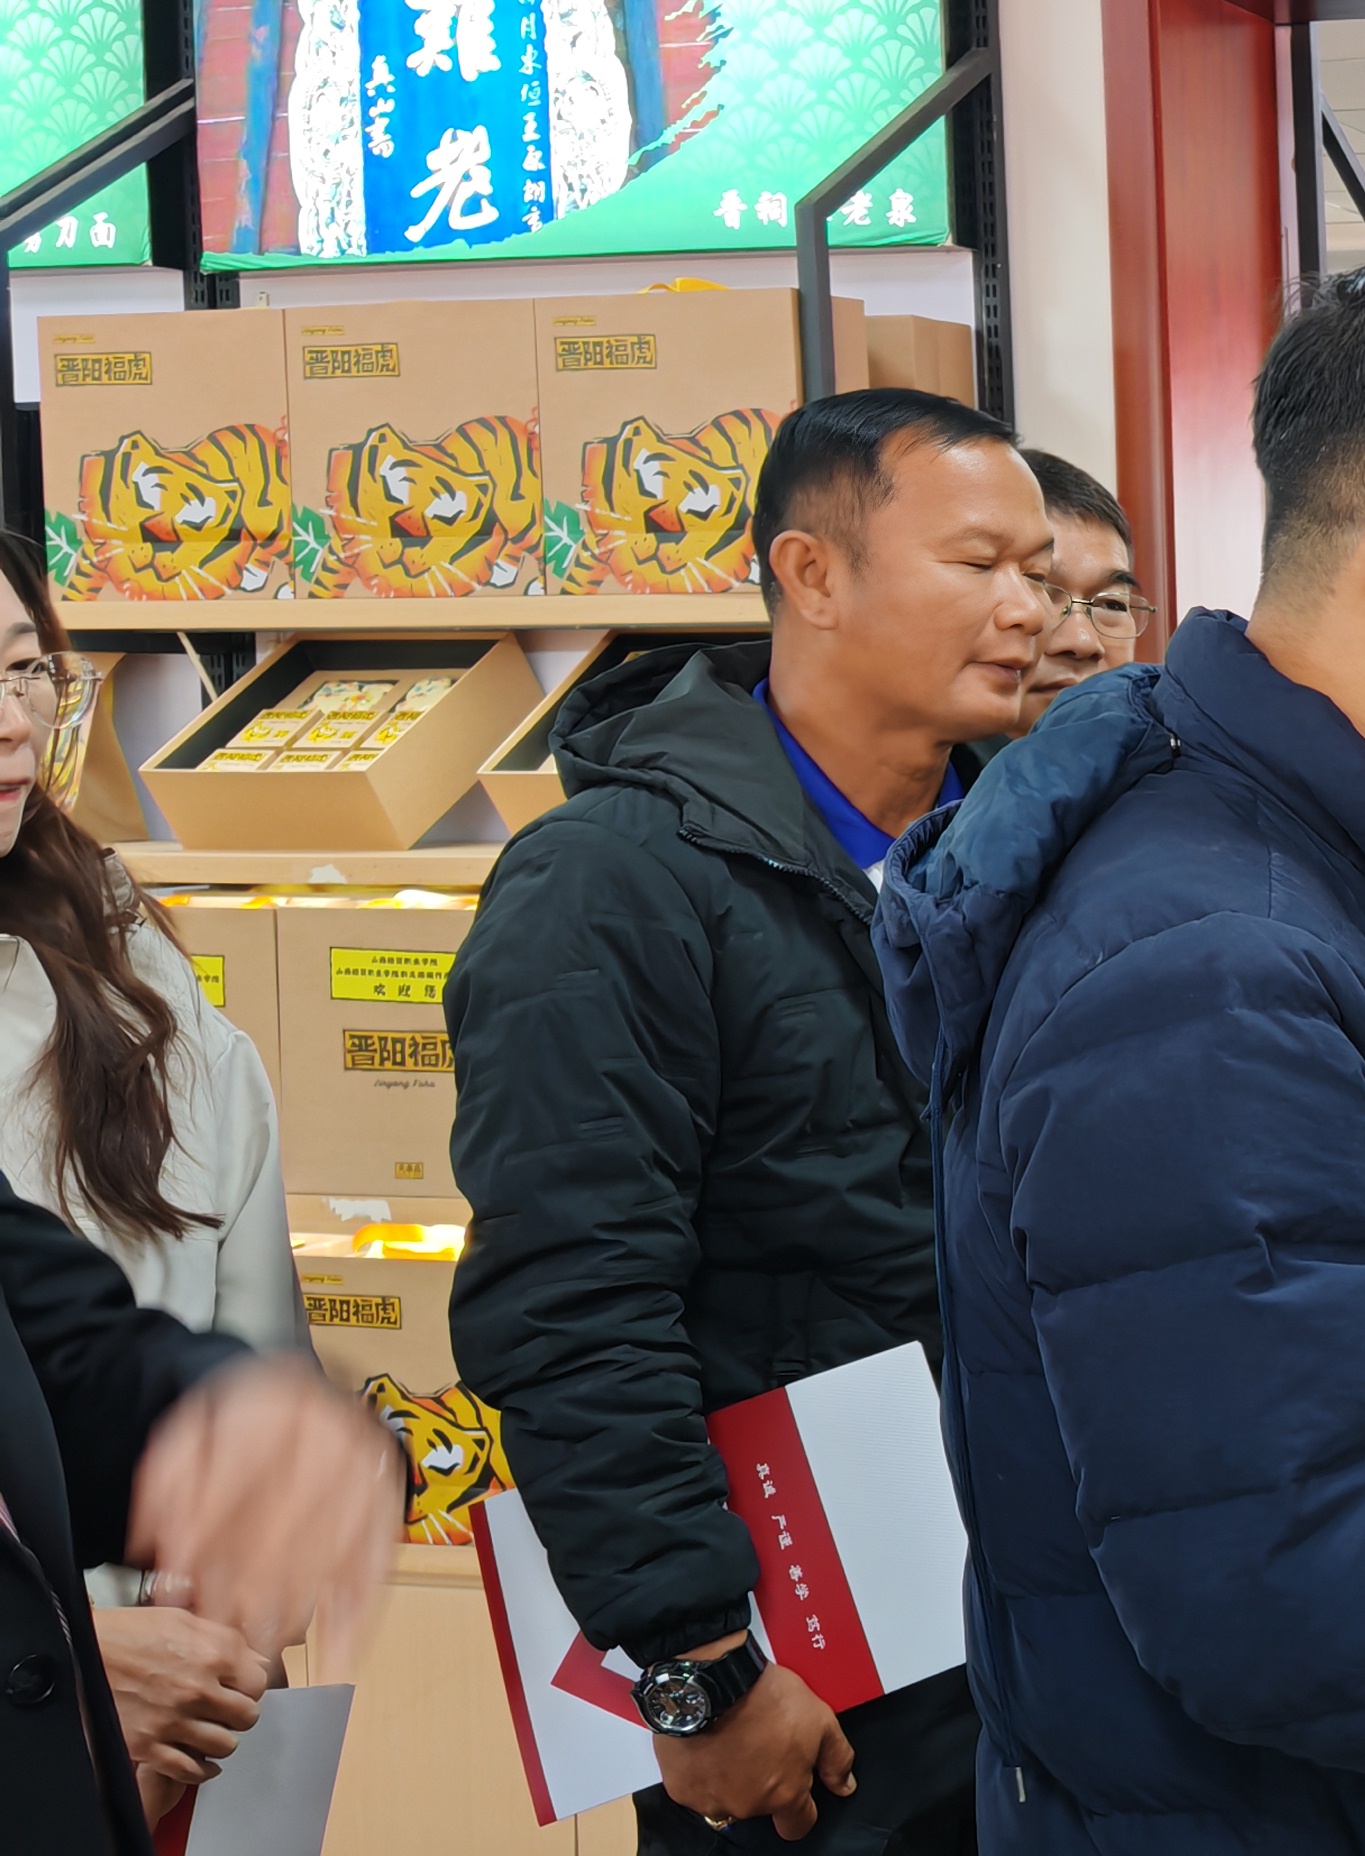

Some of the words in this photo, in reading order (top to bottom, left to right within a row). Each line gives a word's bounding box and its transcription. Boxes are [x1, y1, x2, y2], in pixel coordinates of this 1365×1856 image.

[713, 188, 917, 230] 晋祠老泉
[57, 353, 150, 383] 晋阳福虎
[305, 344, 397, 376] 晋阳福虎
[558, 336, 654, 368] 晋阳福虎
[305, 1296, 398, 1326] 晋阳福虎
